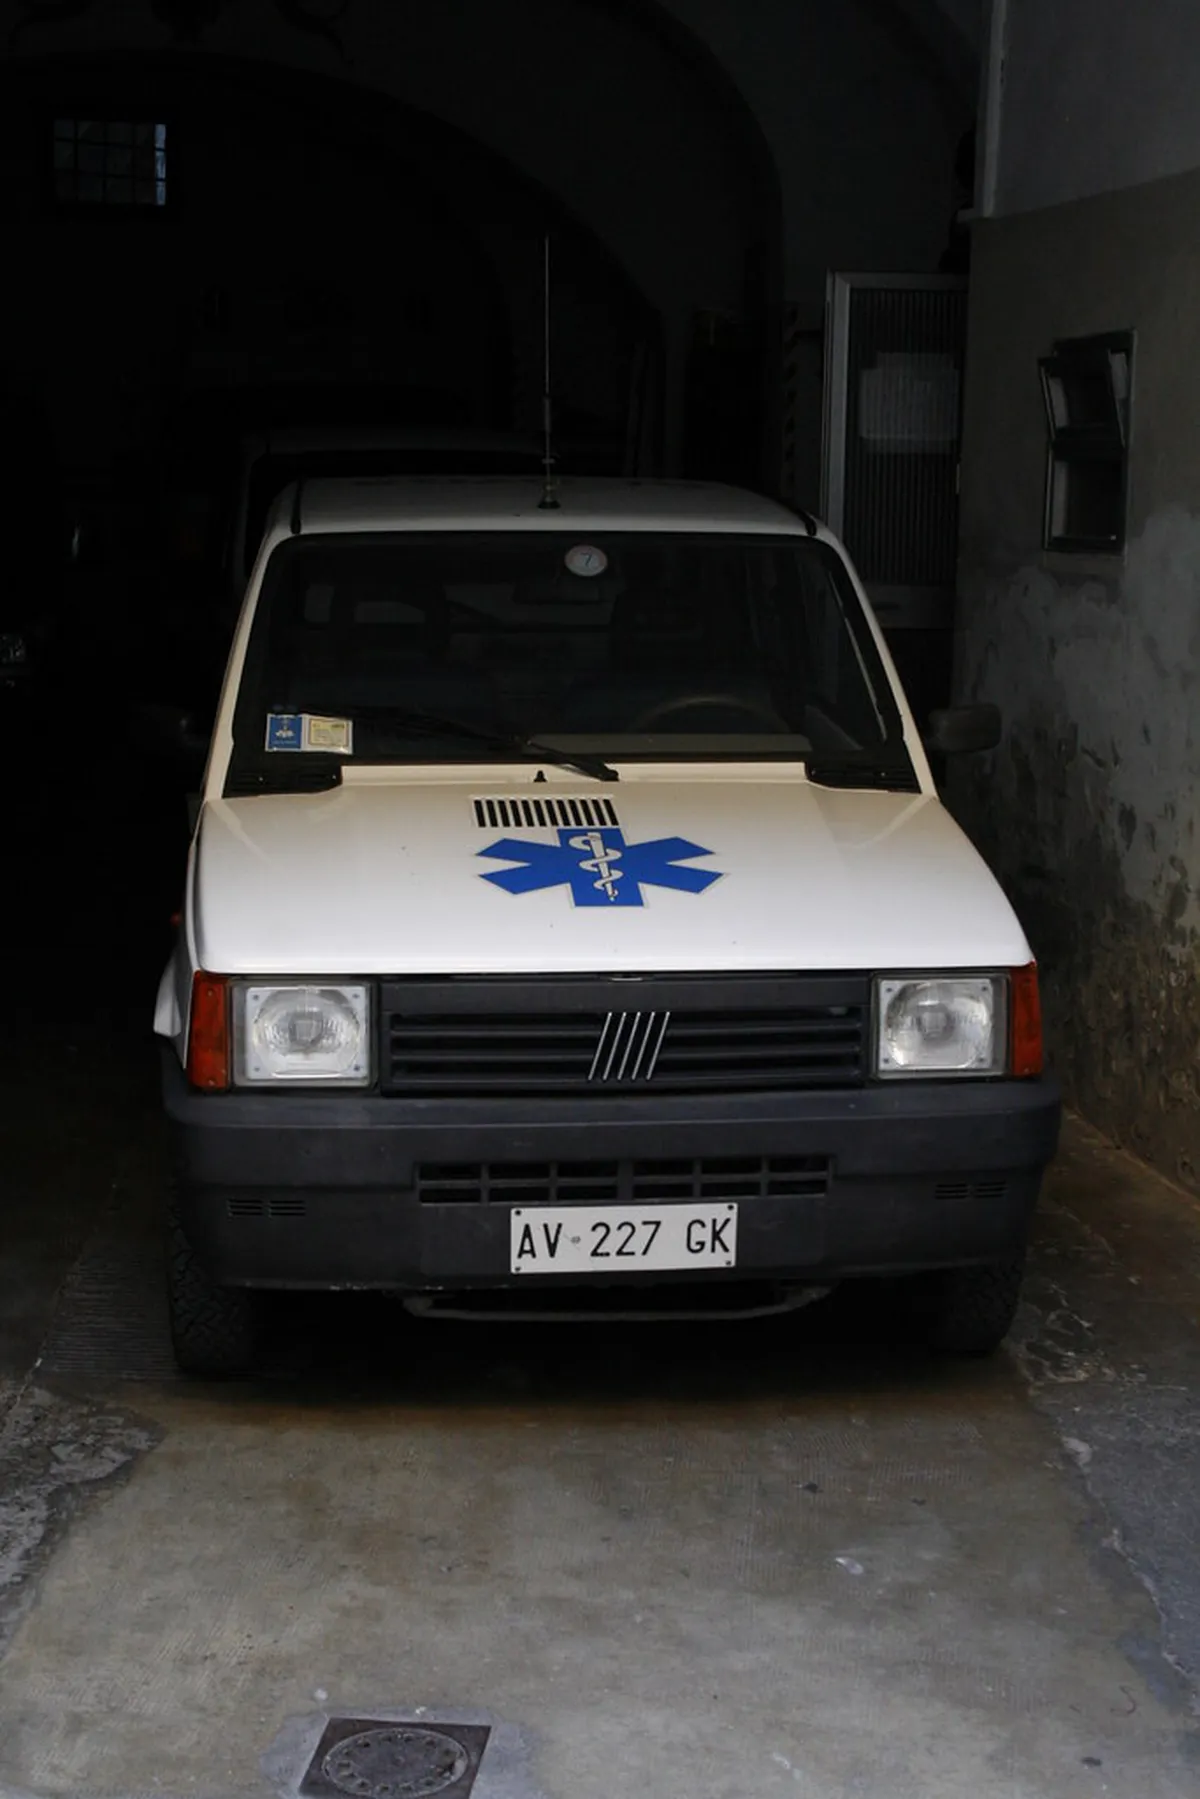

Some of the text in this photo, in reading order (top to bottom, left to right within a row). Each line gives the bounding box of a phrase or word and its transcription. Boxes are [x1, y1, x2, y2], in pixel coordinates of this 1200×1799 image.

[517, 1218, 731, 1259] AV 227 GK
